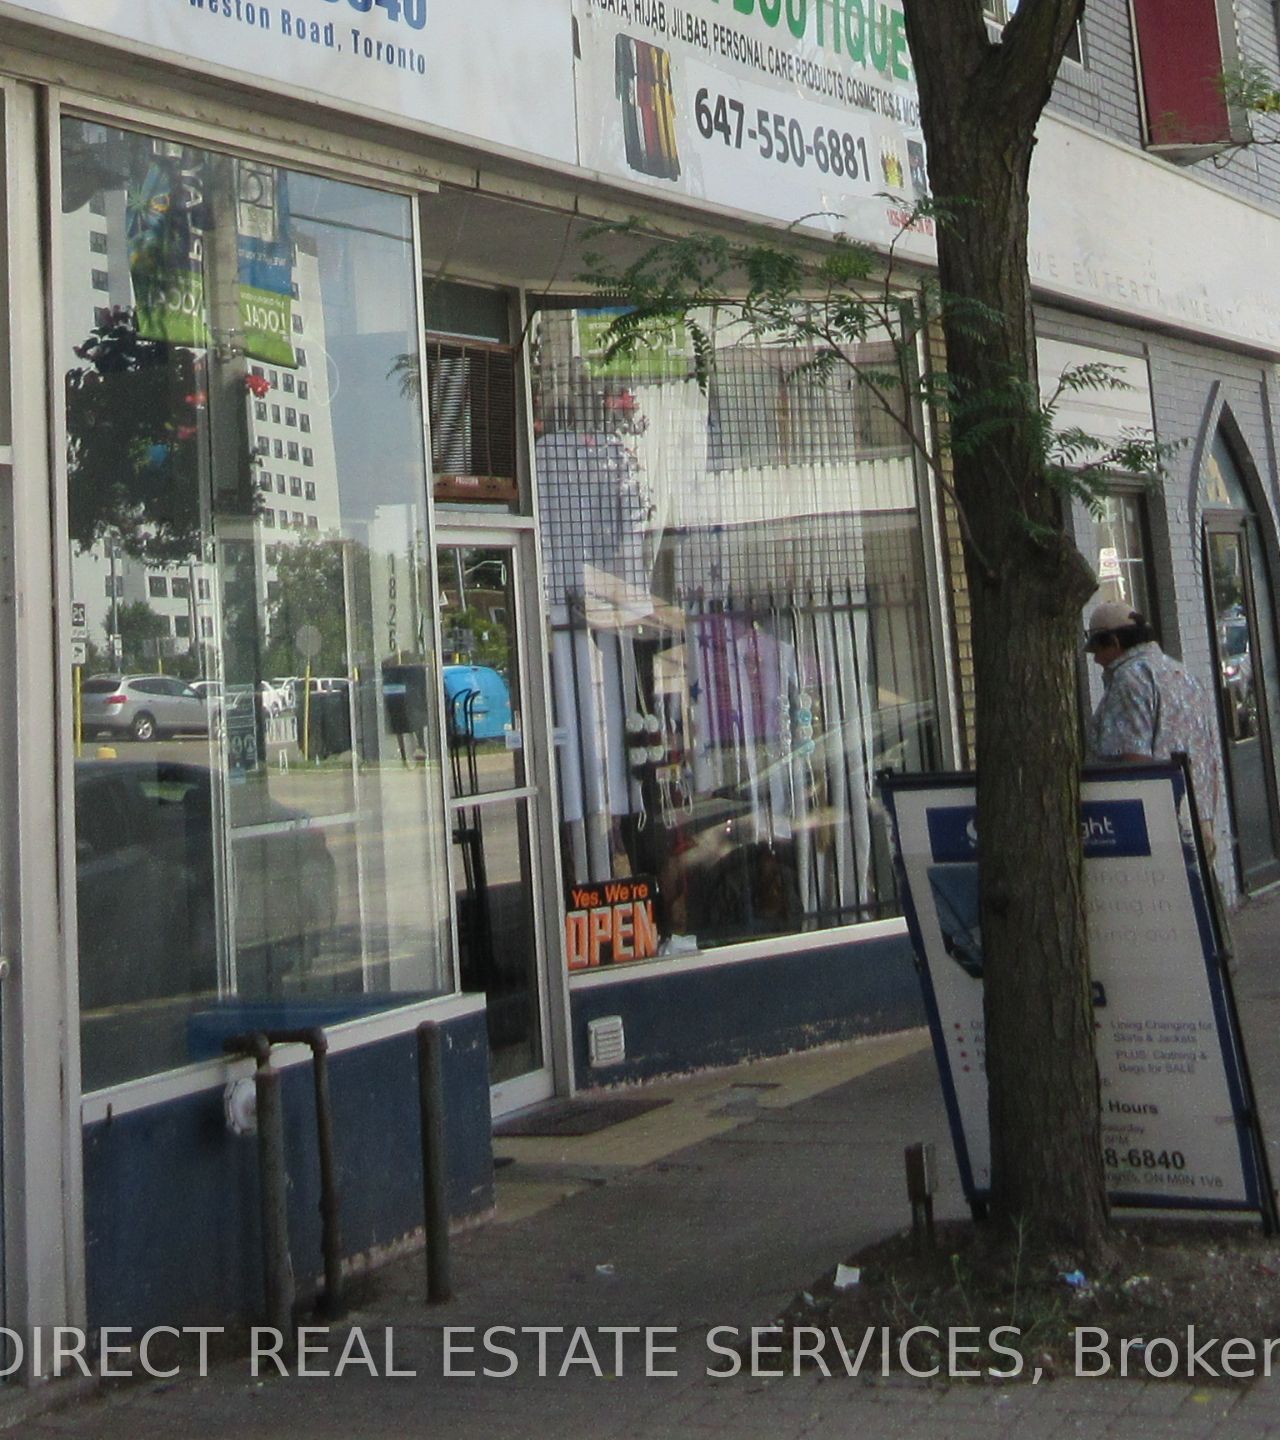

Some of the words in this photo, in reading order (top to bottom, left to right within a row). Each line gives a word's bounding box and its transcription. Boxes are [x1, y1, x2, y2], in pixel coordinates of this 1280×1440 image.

[280, 8, 342, 52] Road,
[350, 28, 426, 75] Toronto
[671, 7, 712, 54] JILBAB,
[712, 23, 767, 72] PERSONAL
[767, 45, 794, 82] CARE
[694, 87, 872, 183] 647-550-6881
[387, 552, 397, 652] 1826
[604, 882, 648, 902] We're
[565, 899, 658, 970] OPEN
[1107, 1100, 1159, 1114] Hours
[1104, 1147, 1185, 1170] 8-6840
